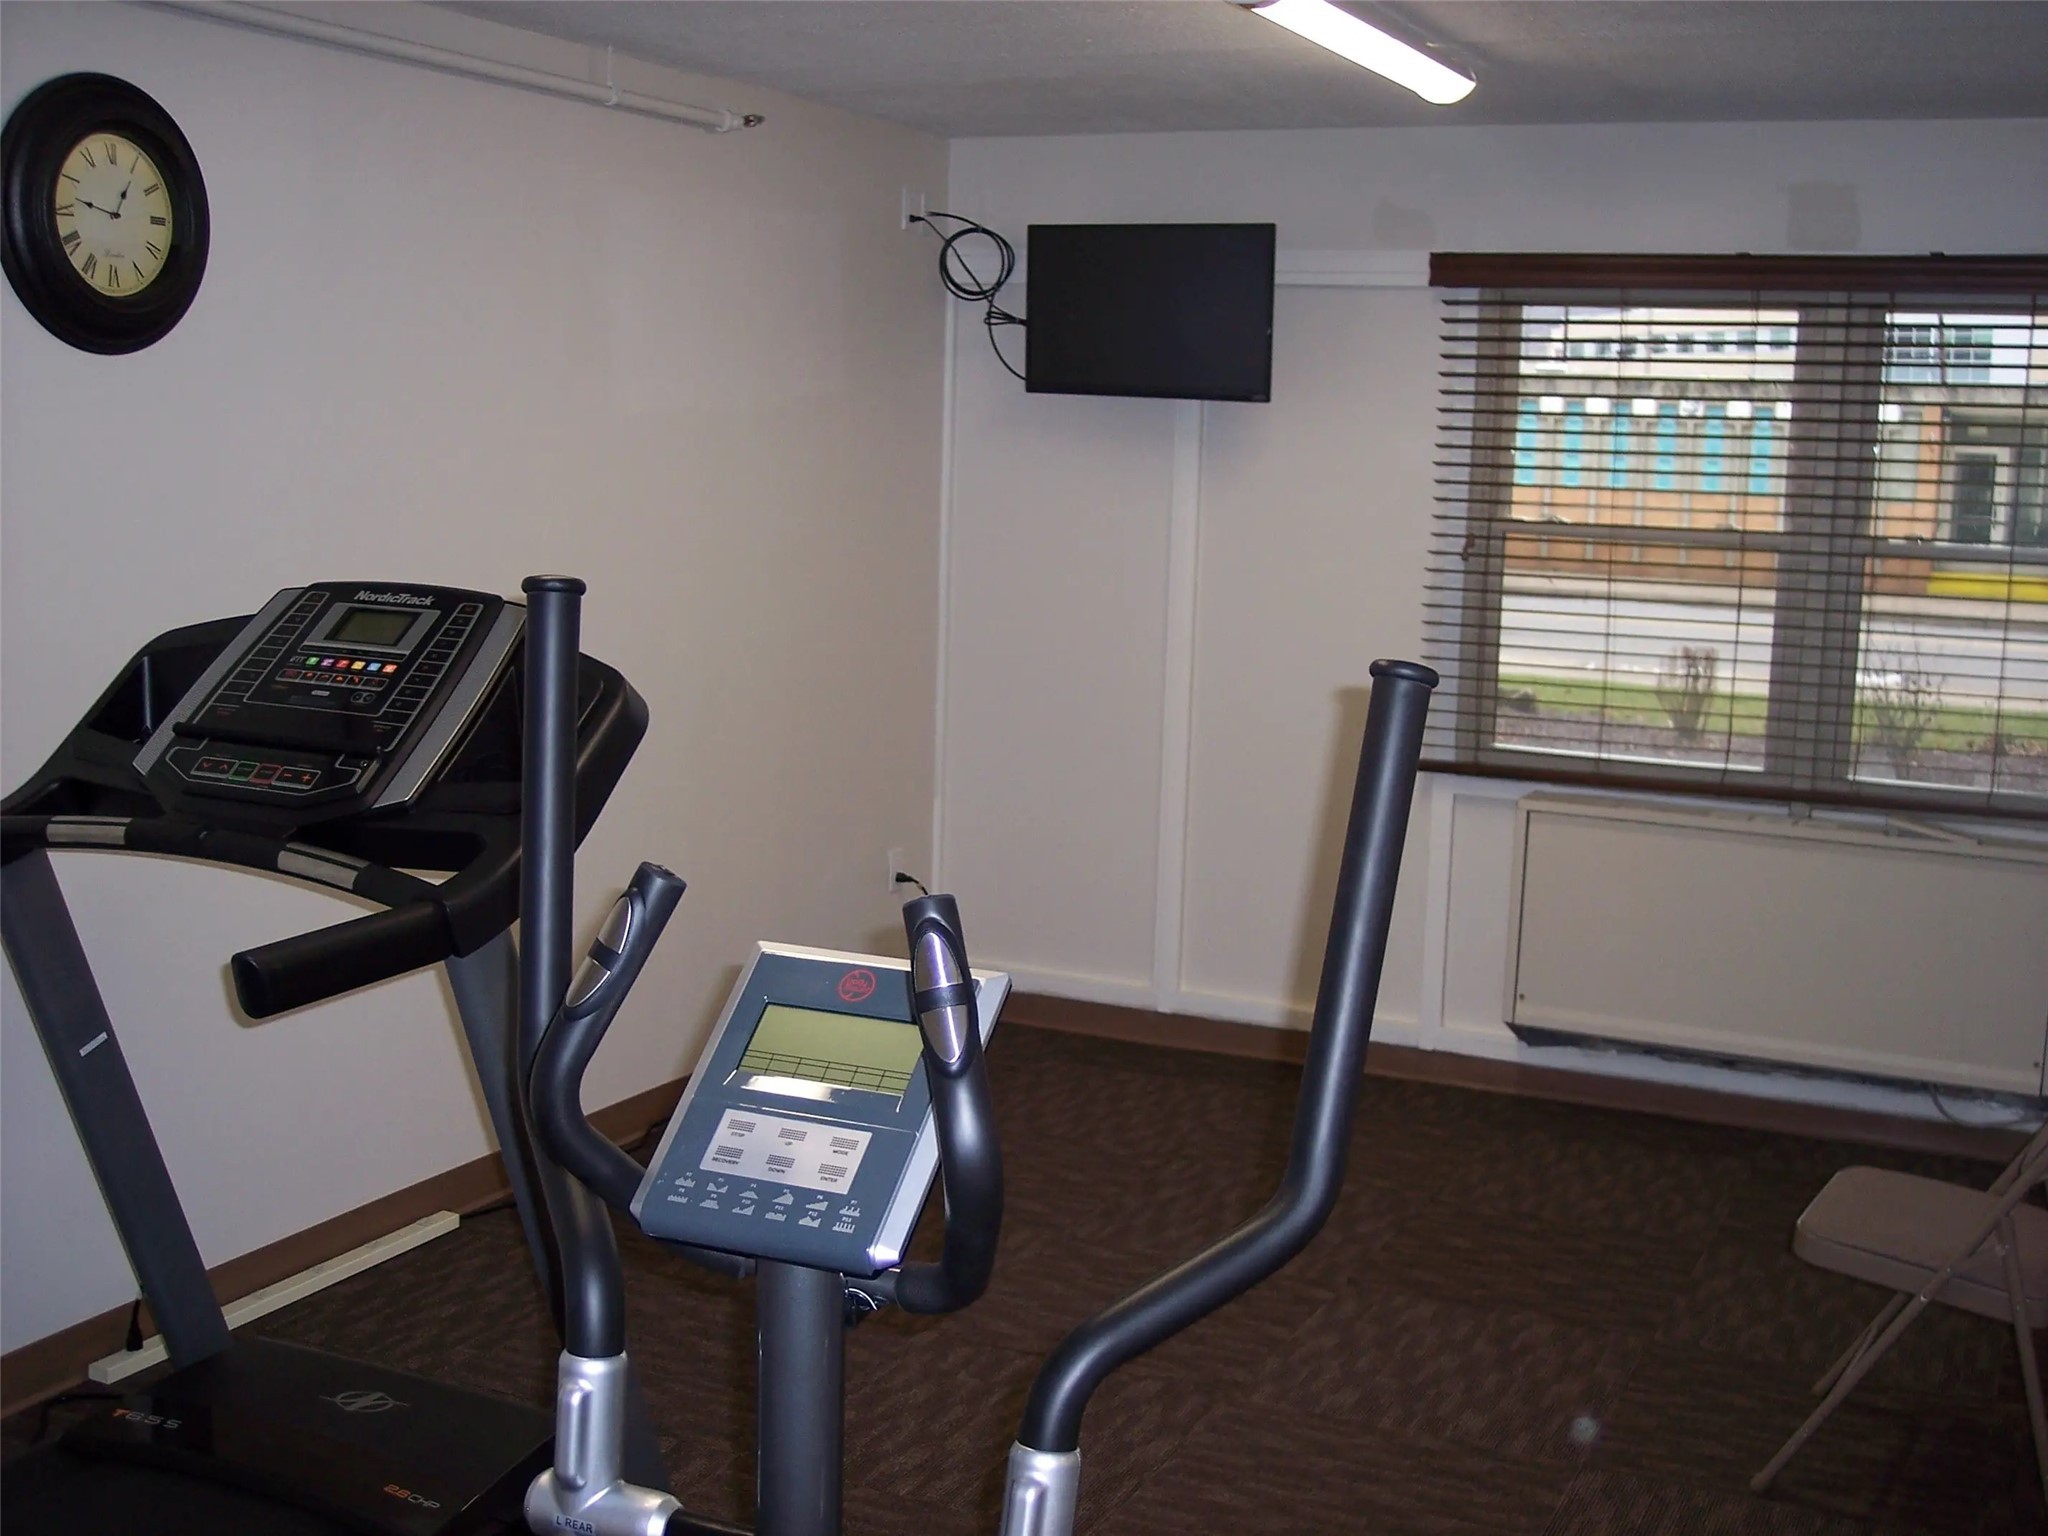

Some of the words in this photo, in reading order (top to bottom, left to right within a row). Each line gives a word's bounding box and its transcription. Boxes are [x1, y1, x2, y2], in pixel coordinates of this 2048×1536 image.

[354, 589, 436, 606] NordicTrack
[711, 1157, 740, 1165] RECOVERY
[556, 1515, 561, 1525] L
[565, 1517, 593, 1534] REAR
